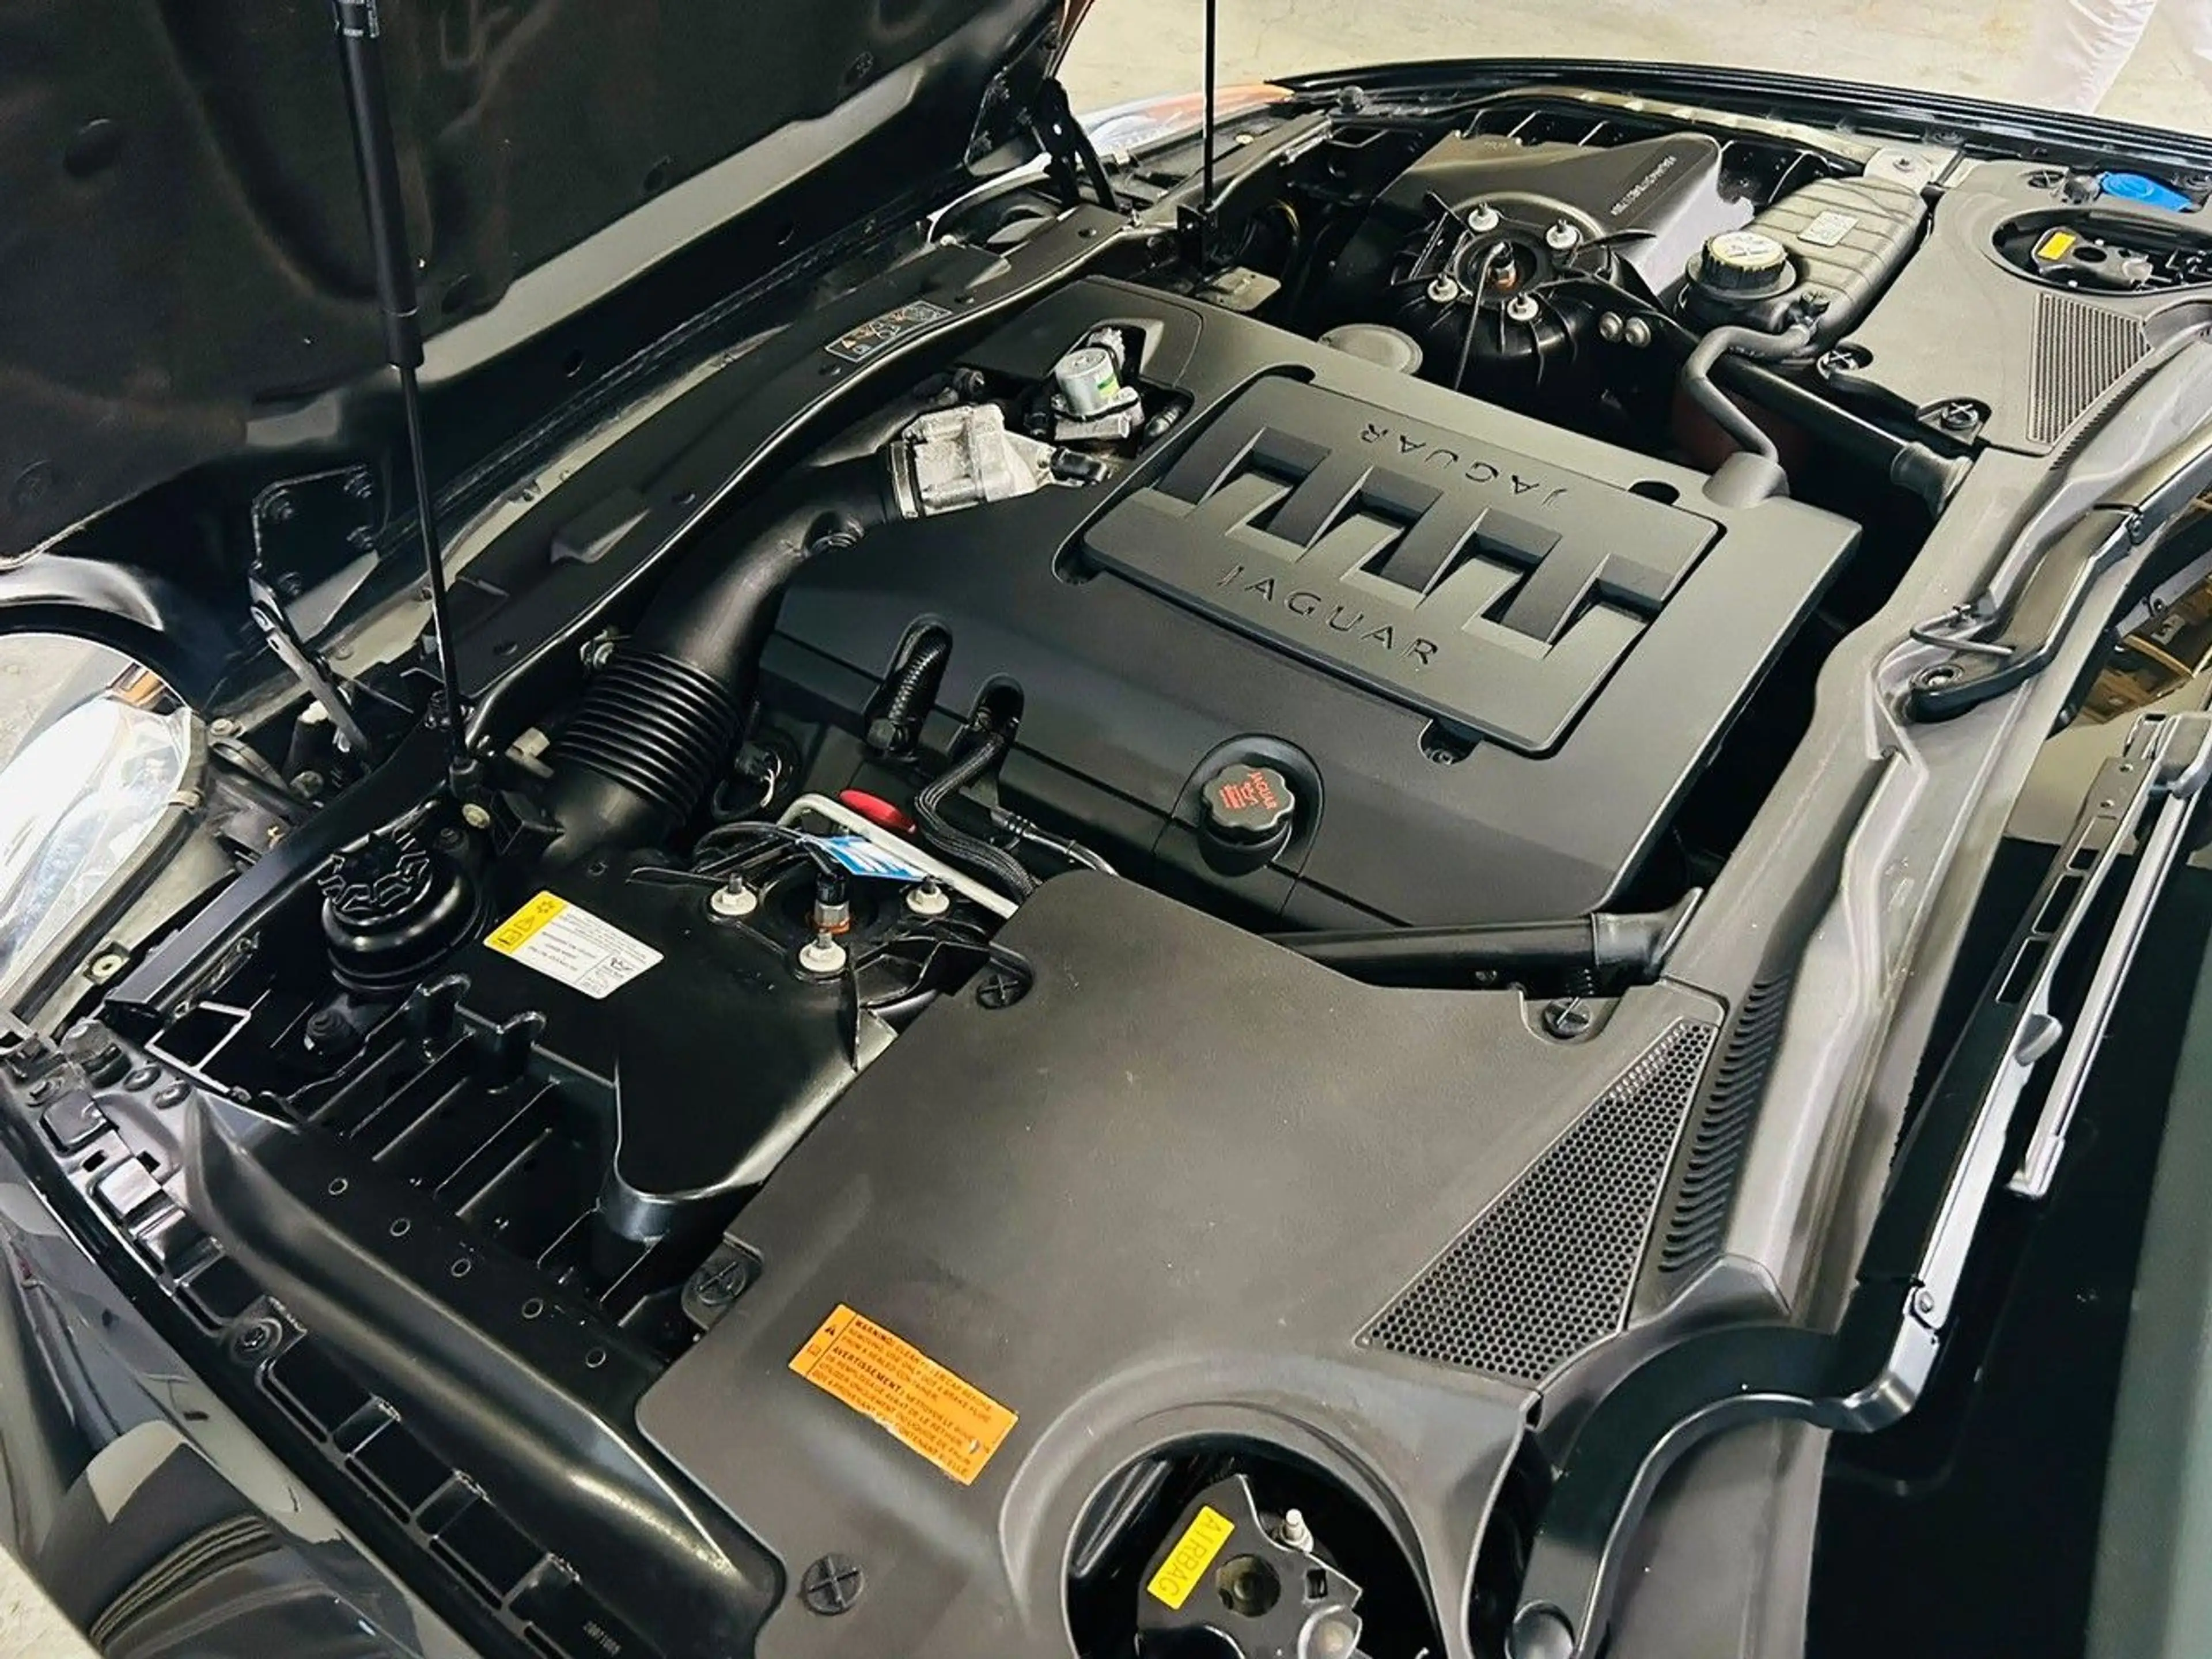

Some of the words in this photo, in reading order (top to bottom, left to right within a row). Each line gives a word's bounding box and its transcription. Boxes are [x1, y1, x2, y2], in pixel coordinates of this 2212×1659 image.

[1361, 423, 1567, 505] JAGUAR
[1216, 563, 1439, 665] JAGUAR
[1158, 1513, 1222, 1596] AIRBAG
